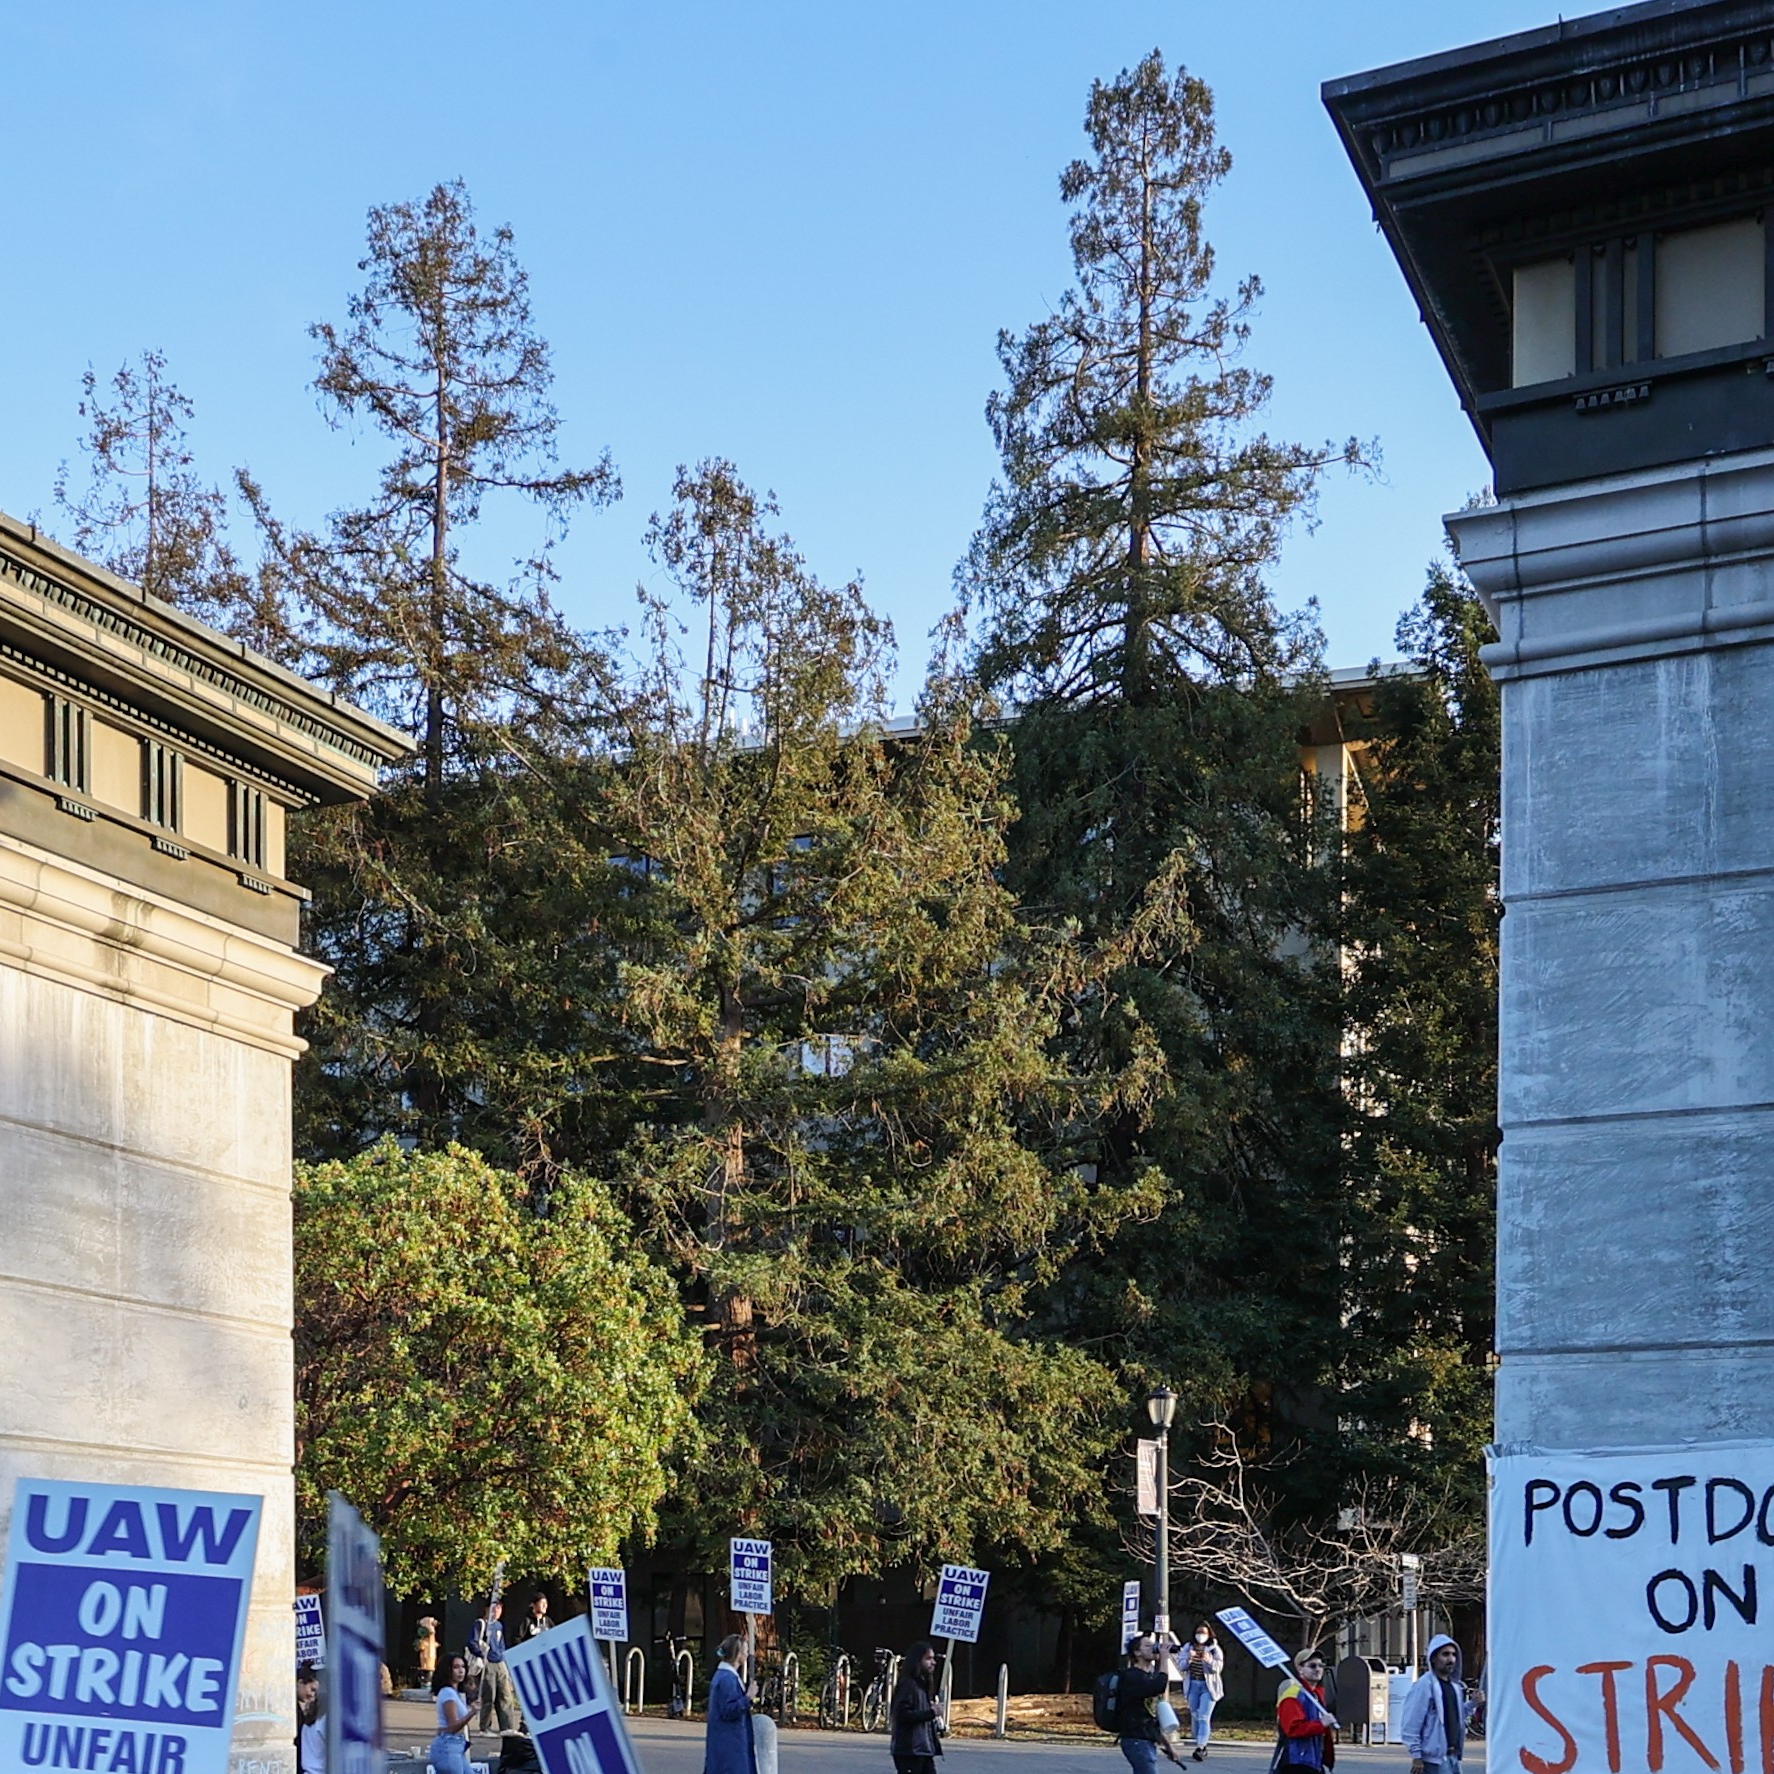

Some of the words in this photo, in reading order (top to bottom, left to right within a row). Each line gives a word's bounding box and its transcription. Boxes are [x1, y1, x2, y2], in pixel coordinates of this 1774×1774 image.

[27, 1494, 252, 1565] UAW
[734, 1541, 768, 1554] UAW
[744, 1557, 758, 1568] ON
[592, 1571, 622, 1582] UAW
[734, 1567, 767, 1581] STRIKE
[945, 1568, 986, 1583] UAW
[601, 1585, 614, 1596] ON
[954, 1584, 971, 1595] ON
[594, 1596, 624, 1609] STRIKE
[940, 1593, 980, 1609] STRIKE
[1647, 1564, 1756, 1634] ON
[78, 1580, 167, 1640] ON
[934, 1624, 975, 1638] PRACTICE
[5, 1641, 224, 1711] STRIKE
[514, 1635, 596, 1721] UAW
